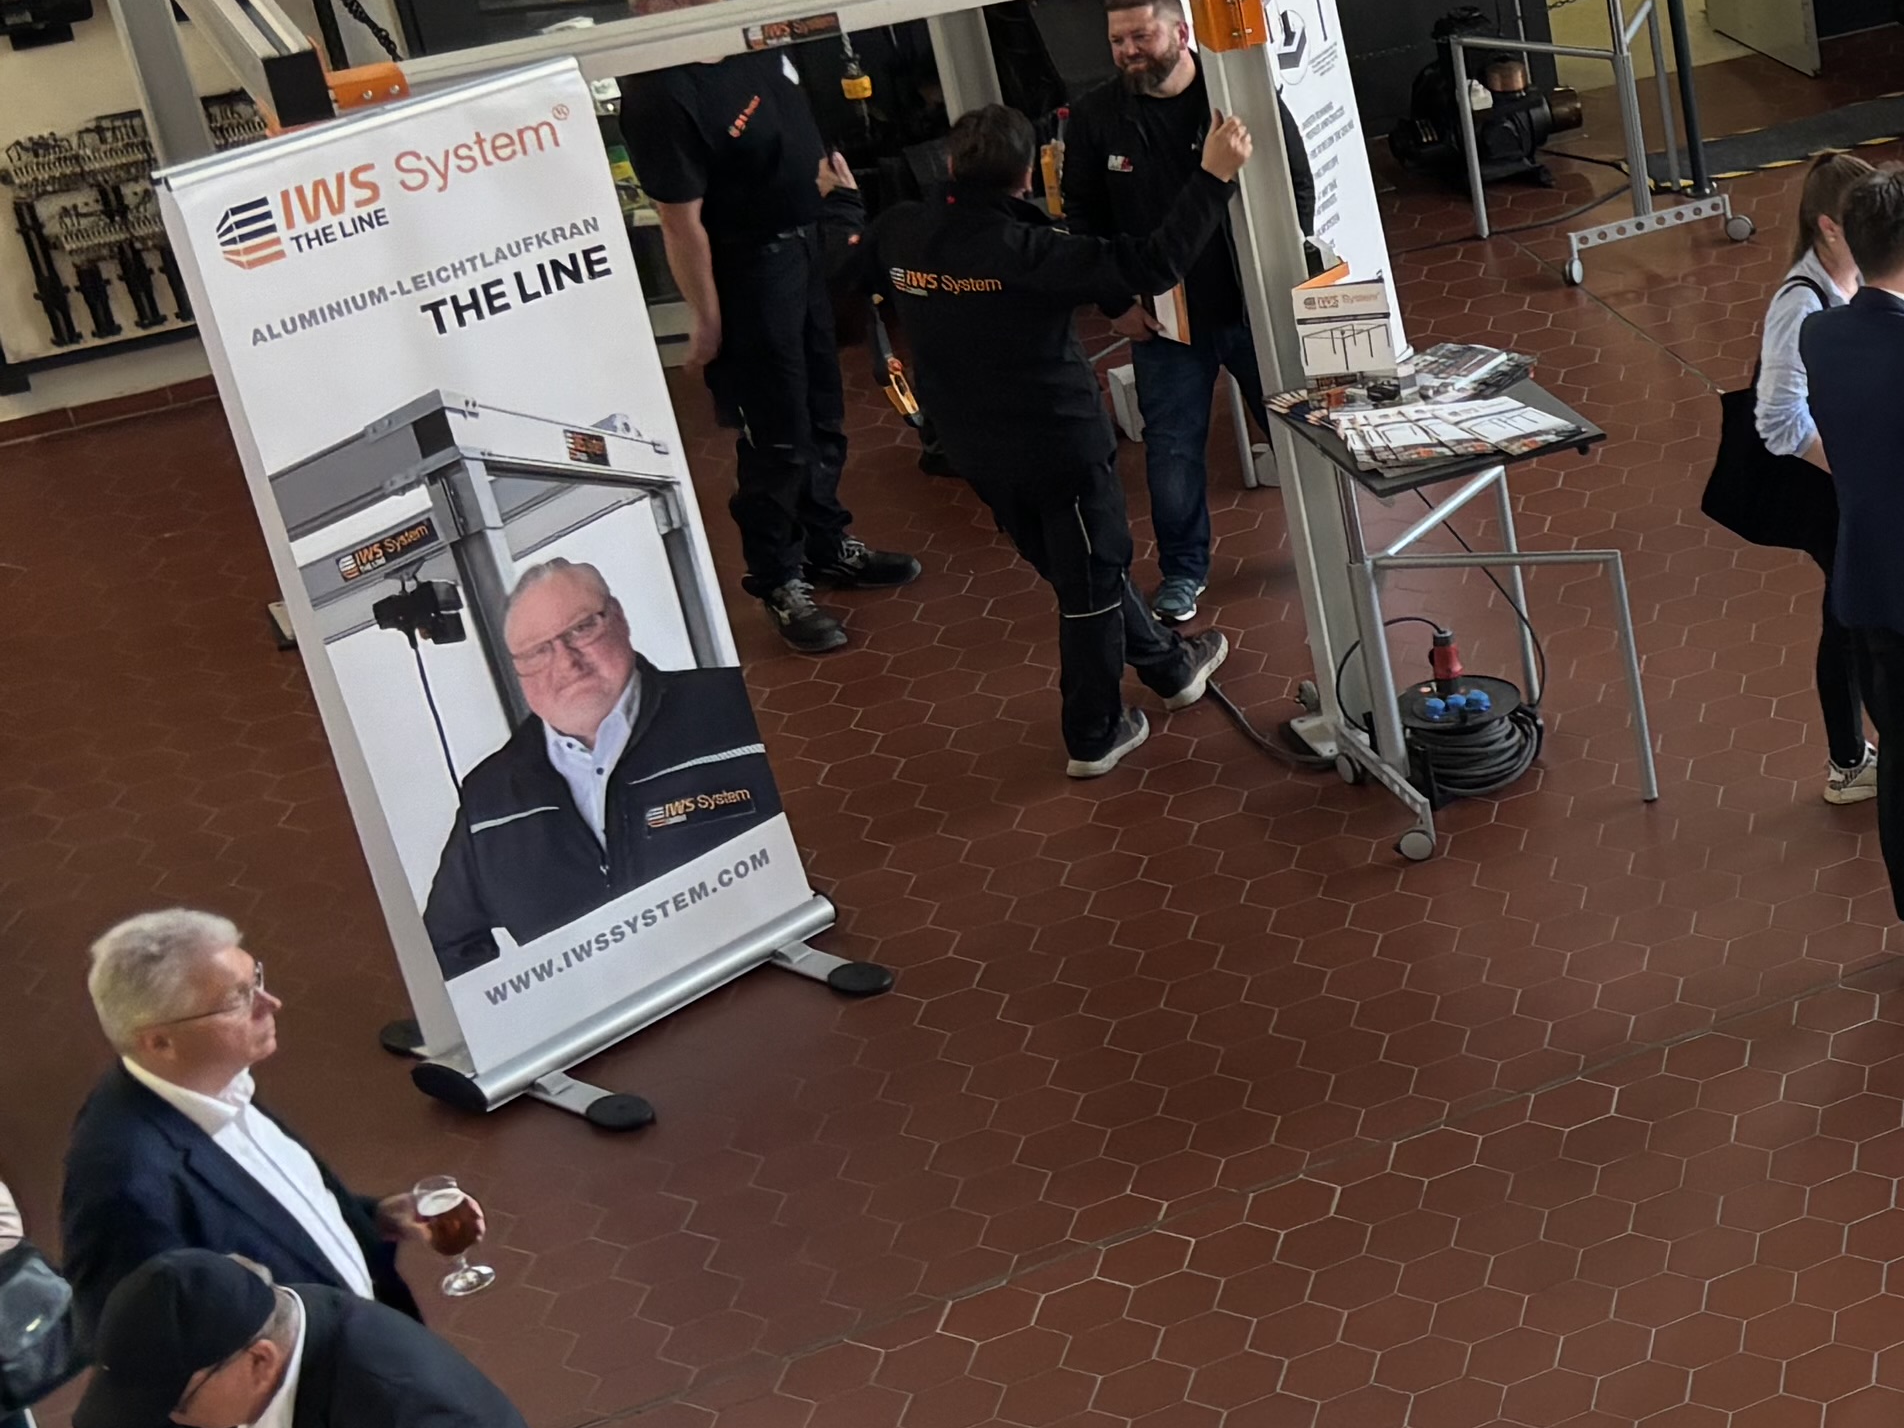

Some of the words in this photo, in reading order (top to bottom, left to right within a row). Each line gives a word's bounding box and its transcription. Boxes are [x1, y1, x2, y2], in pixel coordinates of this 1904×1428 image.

[281, 163, 382, 230] IWS
[290, 228, 336, 254] THE
[339, 208, 389, 243] LINE
[251, 217, 600, 347] ALUMINIUM-LEICHTLAUFKRAN
[421, 279, 511, 335] THE
[519, 245, 612, 304] LINE
[665, 797, 695, 818] IWS
[698, 787, 751, 812] System
[484, 847, 772, 1007] WWW.IWSSYSTEM.COM
